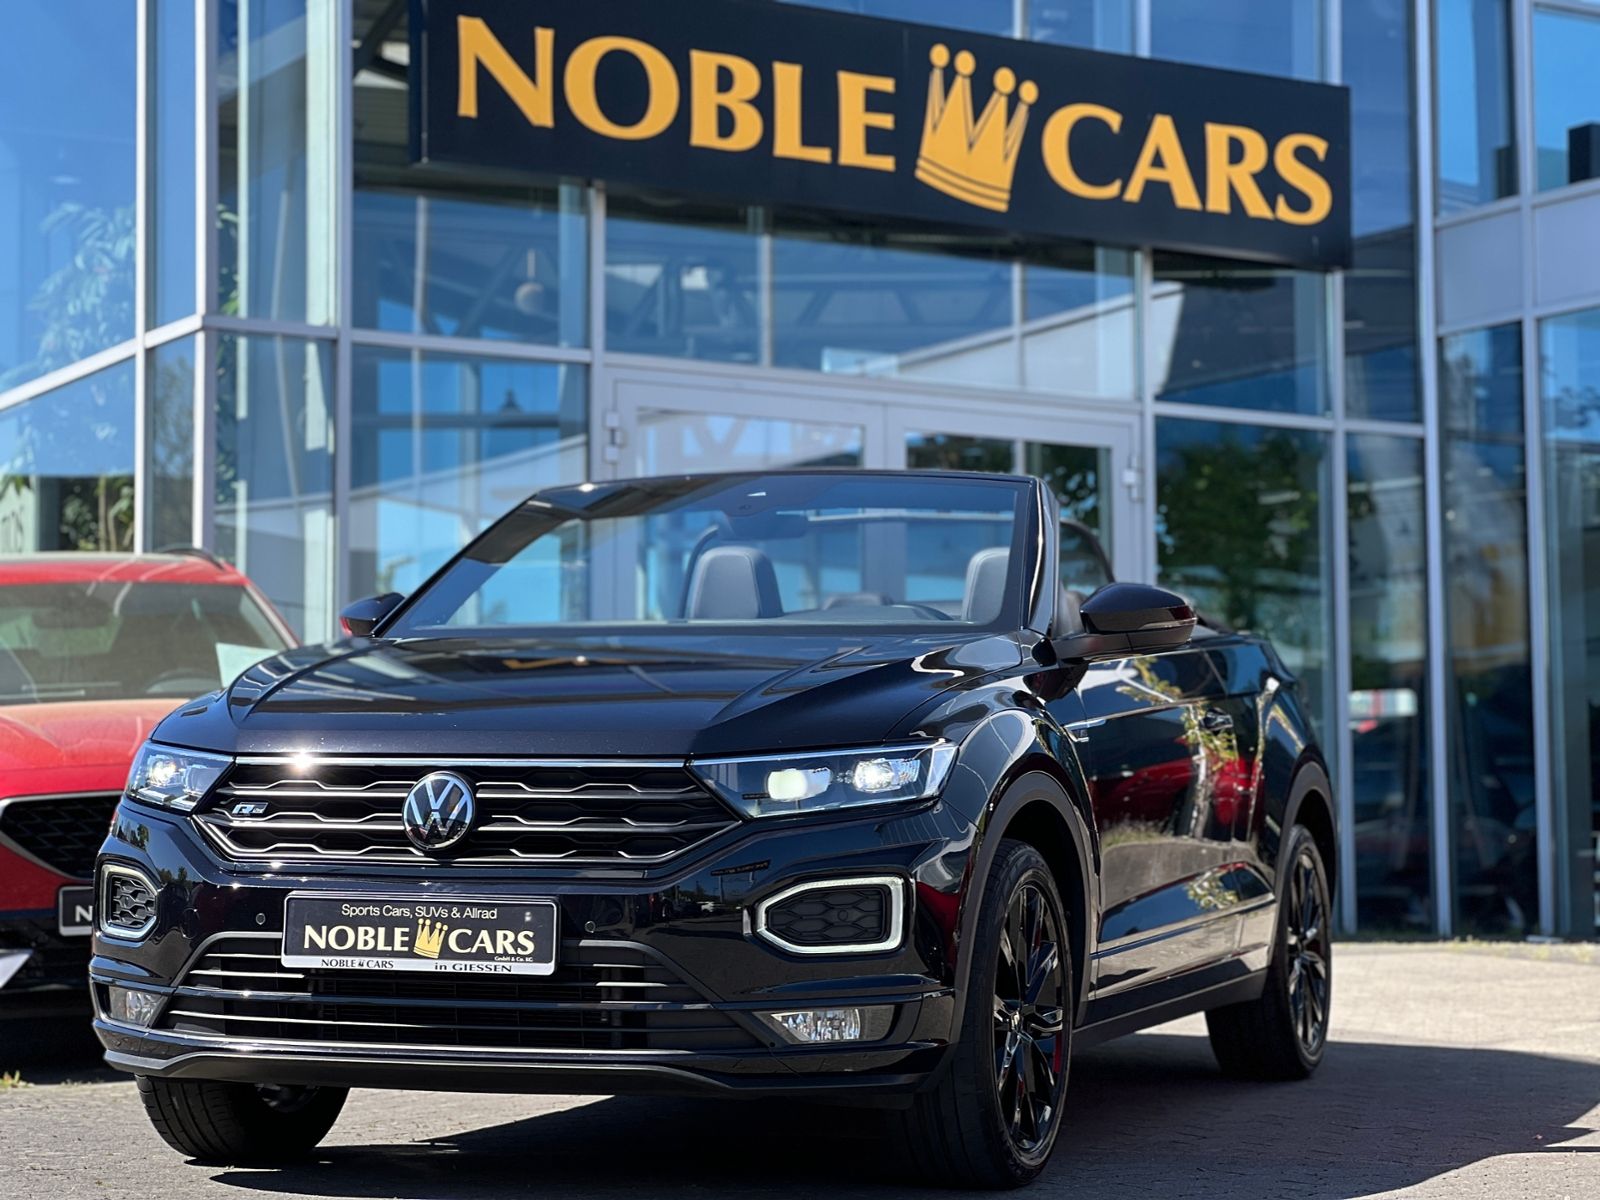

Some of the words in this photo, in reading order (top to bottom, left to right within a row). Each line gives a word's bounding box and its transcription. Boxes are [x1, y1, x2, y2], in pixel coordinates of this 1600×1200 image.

[457, 14, 897, 173] NOBLE
[1042, 103, 1332, 225] CARS
[341, 903, 381, 918] Sports
[382, 904, 413, 919] Cars,
[415, 905, 449, 918] SUVs
[450, 906, 461, 919] &
[462, 907, 498, 920] Allrad
[303, 924, 410, 952] NOBLE
[448, 928, 535, 956] CARS
[320, 958, 357, 968] NOBLE
[366, 959, 395, 969] CARS
[434, 962, 448, 971] in
[452, 962, 513, 973] GIESSEN
